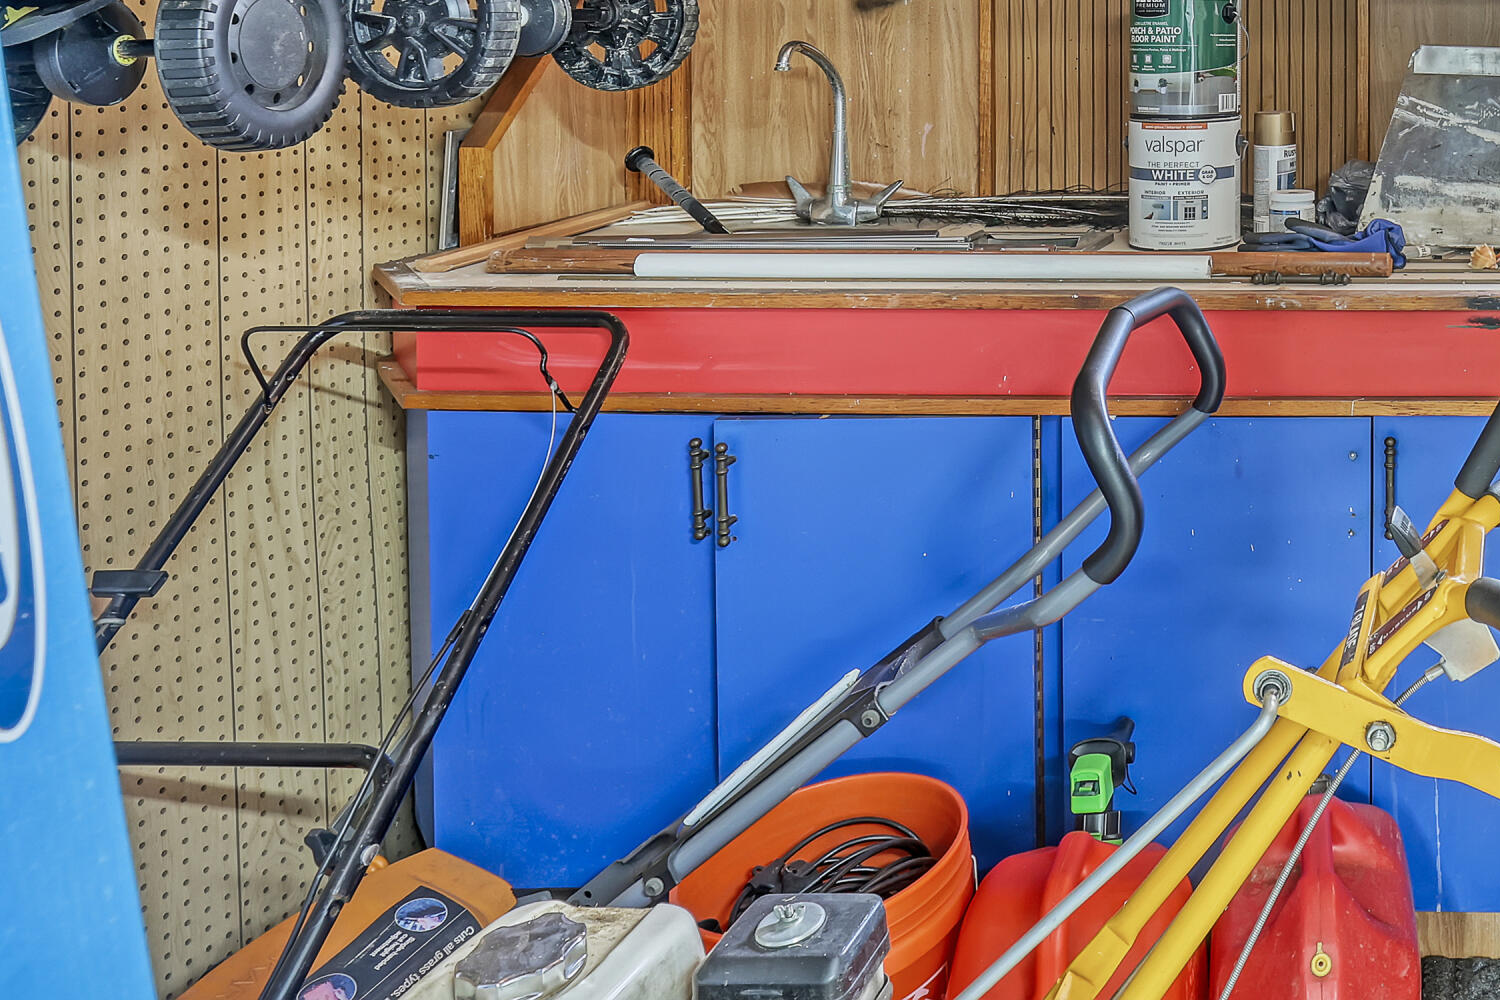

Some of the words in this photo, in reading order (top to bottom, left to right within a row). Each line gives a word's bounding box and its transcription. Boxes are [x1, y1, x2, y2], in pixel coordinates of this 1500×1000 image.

[1147, 27, 1155, 35] &
[1155, 26, 1182, 35] PATIO
[1150, 35, 1177, 43] PAINT
[1145, 135, 1202, 157] valspar
[1163, 161, 1200, 169] PERFECT
[1151, 169, 1195, 181] WHITE
[454, 925, 475, 946] Cuts
[441, 943, 456, 957] all
[418, 949, 447, 976] grass
[390, 973, 421, 997] types.
